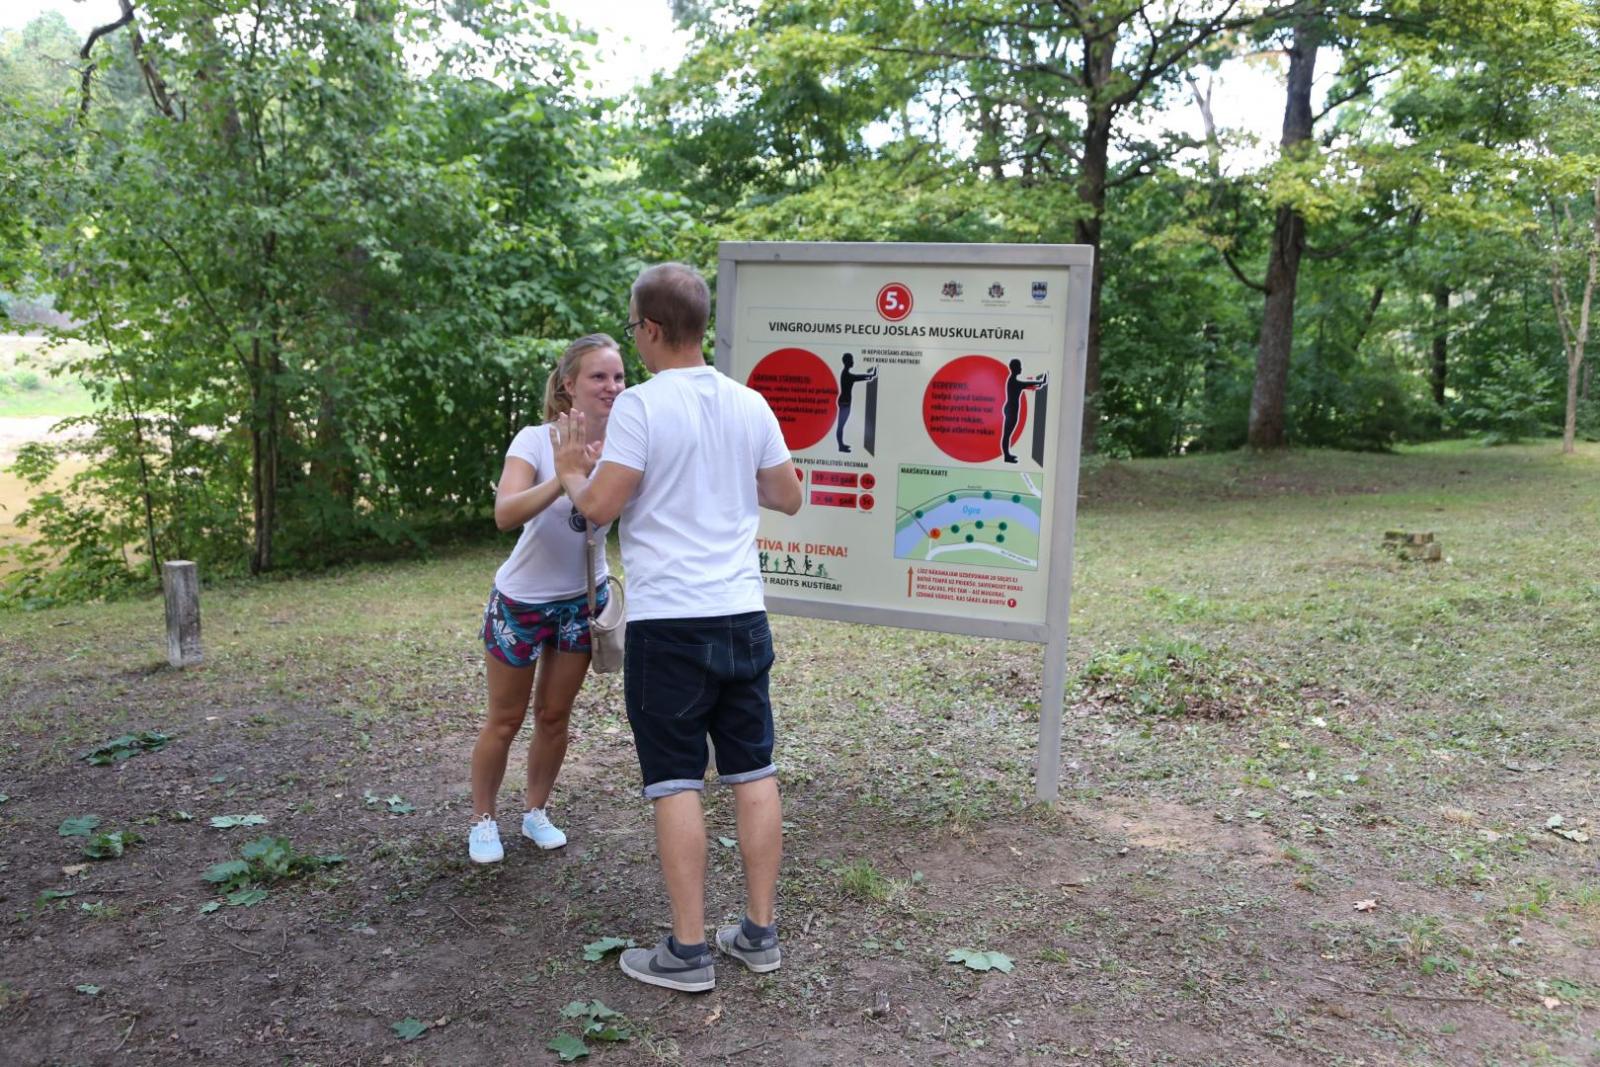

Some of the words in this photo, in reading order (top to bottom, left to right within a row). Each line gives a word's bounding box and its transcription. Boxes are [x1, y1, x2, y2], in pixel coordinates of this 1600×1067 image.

[885, 291, 904, 310] 5.
[769, 321, 842, 334] VINGROJUMS
[844, 324, 880, 335] PLECU
[883, 325, 926, 337] JOSLAS
[929, 326, 1024, 340] MUSKULATŪRAI
[931, 469, 948, 477] KARTE
[756, 537, 783, 551] TĪVA
[788, 541, 800, 553] IK
[805, 543, 848, 558] DIENA!
